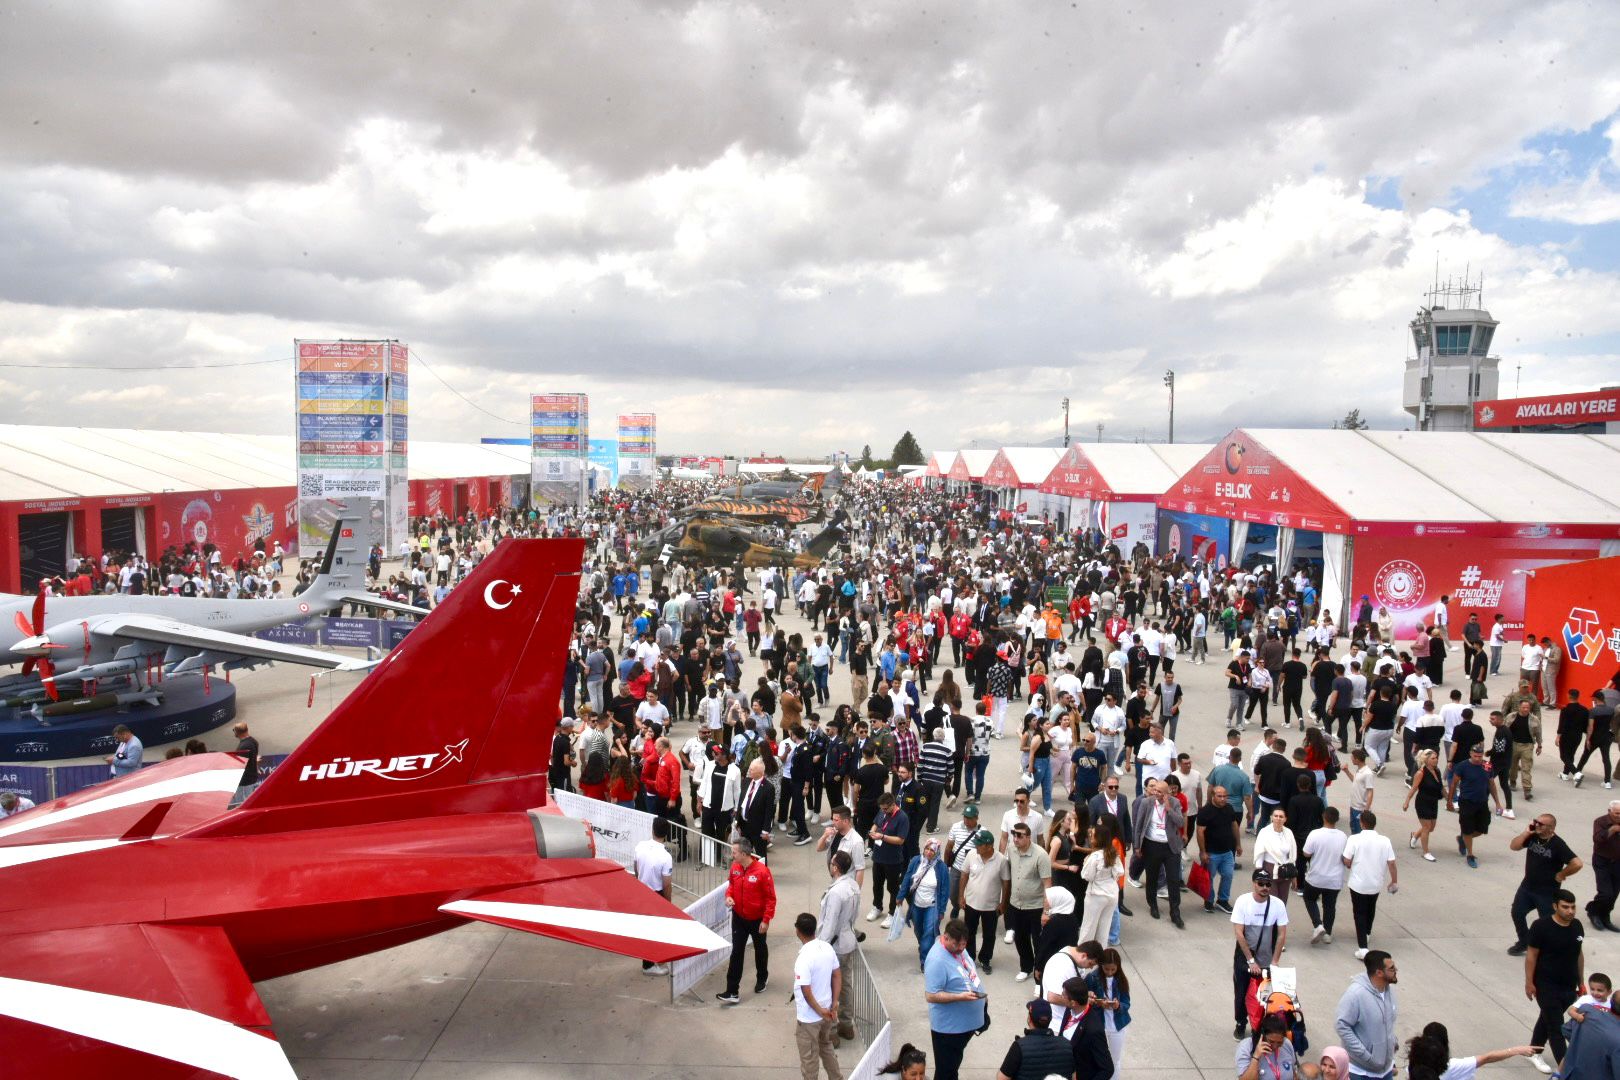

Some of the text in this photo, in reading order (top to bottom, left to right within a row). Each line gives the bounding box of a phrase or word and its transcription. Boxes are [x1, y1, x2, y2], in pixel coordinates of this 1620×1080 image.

[1516, 399, 1617, 418] AYAKLARI YERE
[1215, 482, 1252, 499] E-BLOK
[299, 752, 440, 782] HÜRJET
